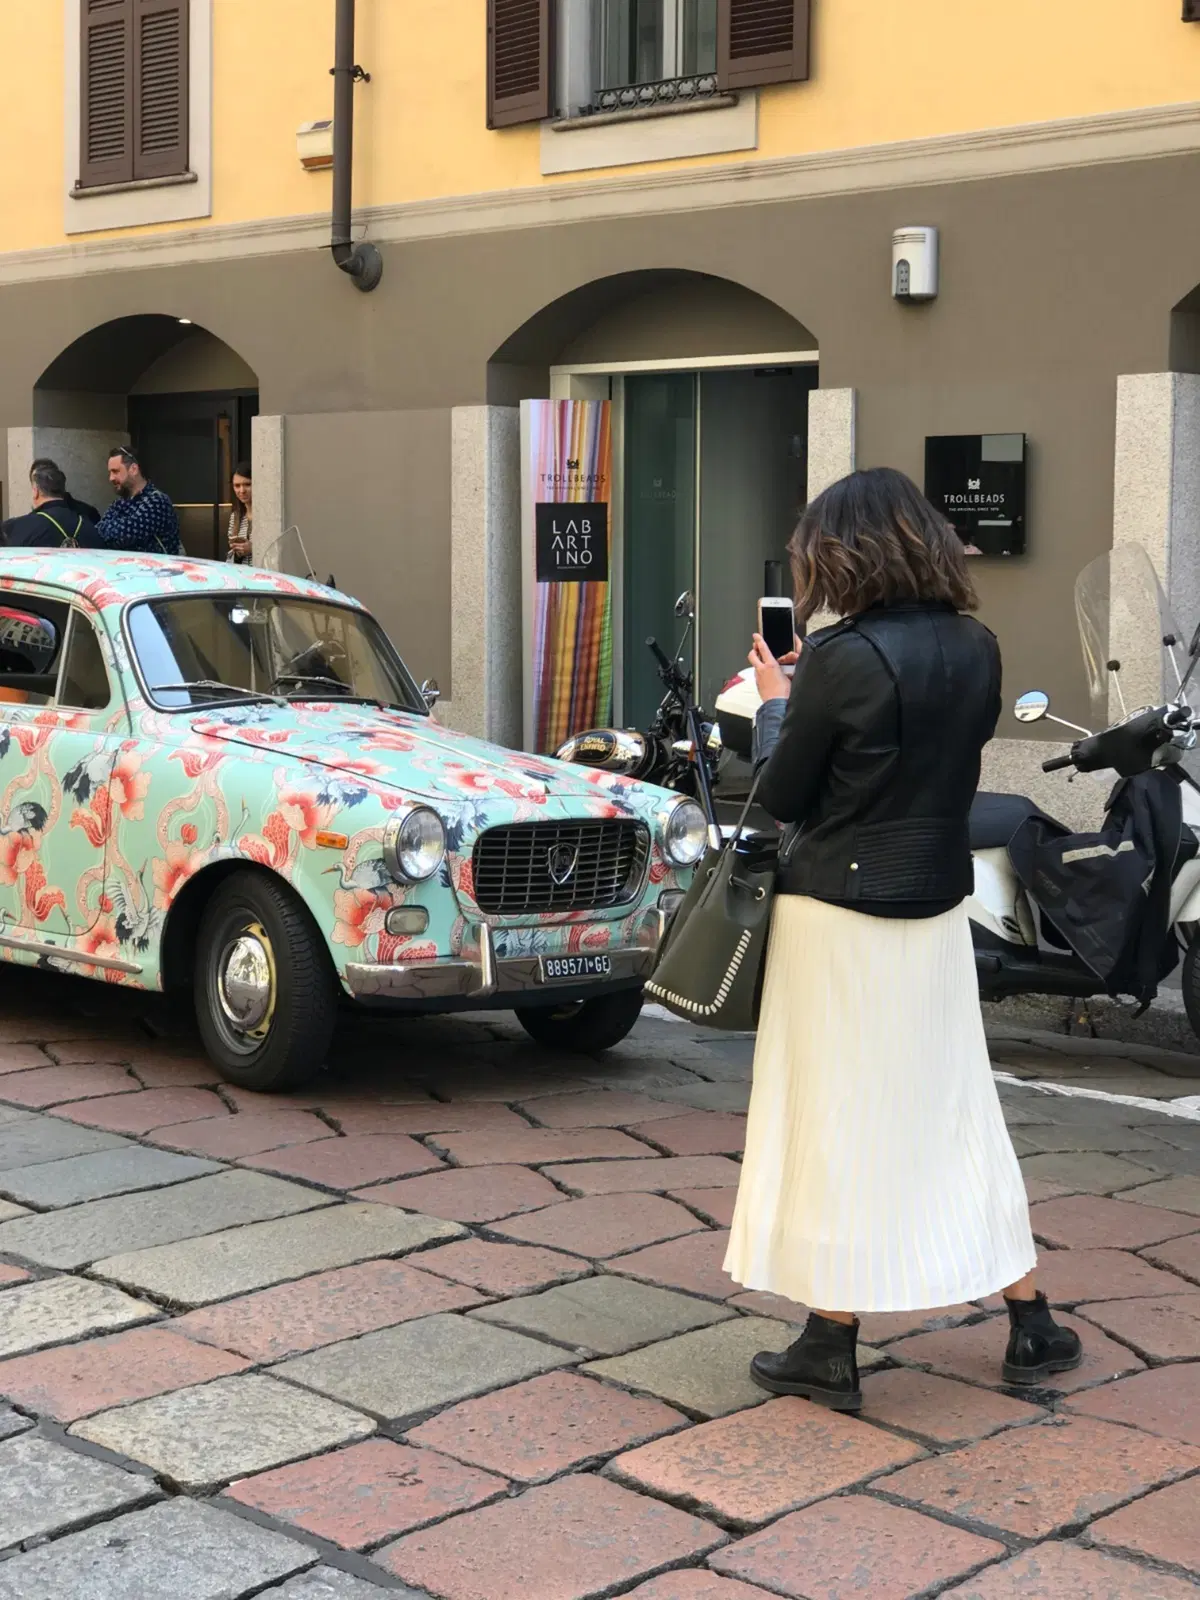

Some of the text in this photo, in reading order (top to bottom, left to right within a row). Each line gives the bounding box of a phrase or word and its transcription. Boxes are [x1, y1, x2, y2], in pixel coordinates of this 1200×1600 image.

[540, 473, 606, 483] TROLLBEADS
[943, 493, 1005, 503] TROLLBEADS
[552, 519, 592, 534] LAB
[551, 535, 592, 550] ART
[556, 550, 593, 565] INO
